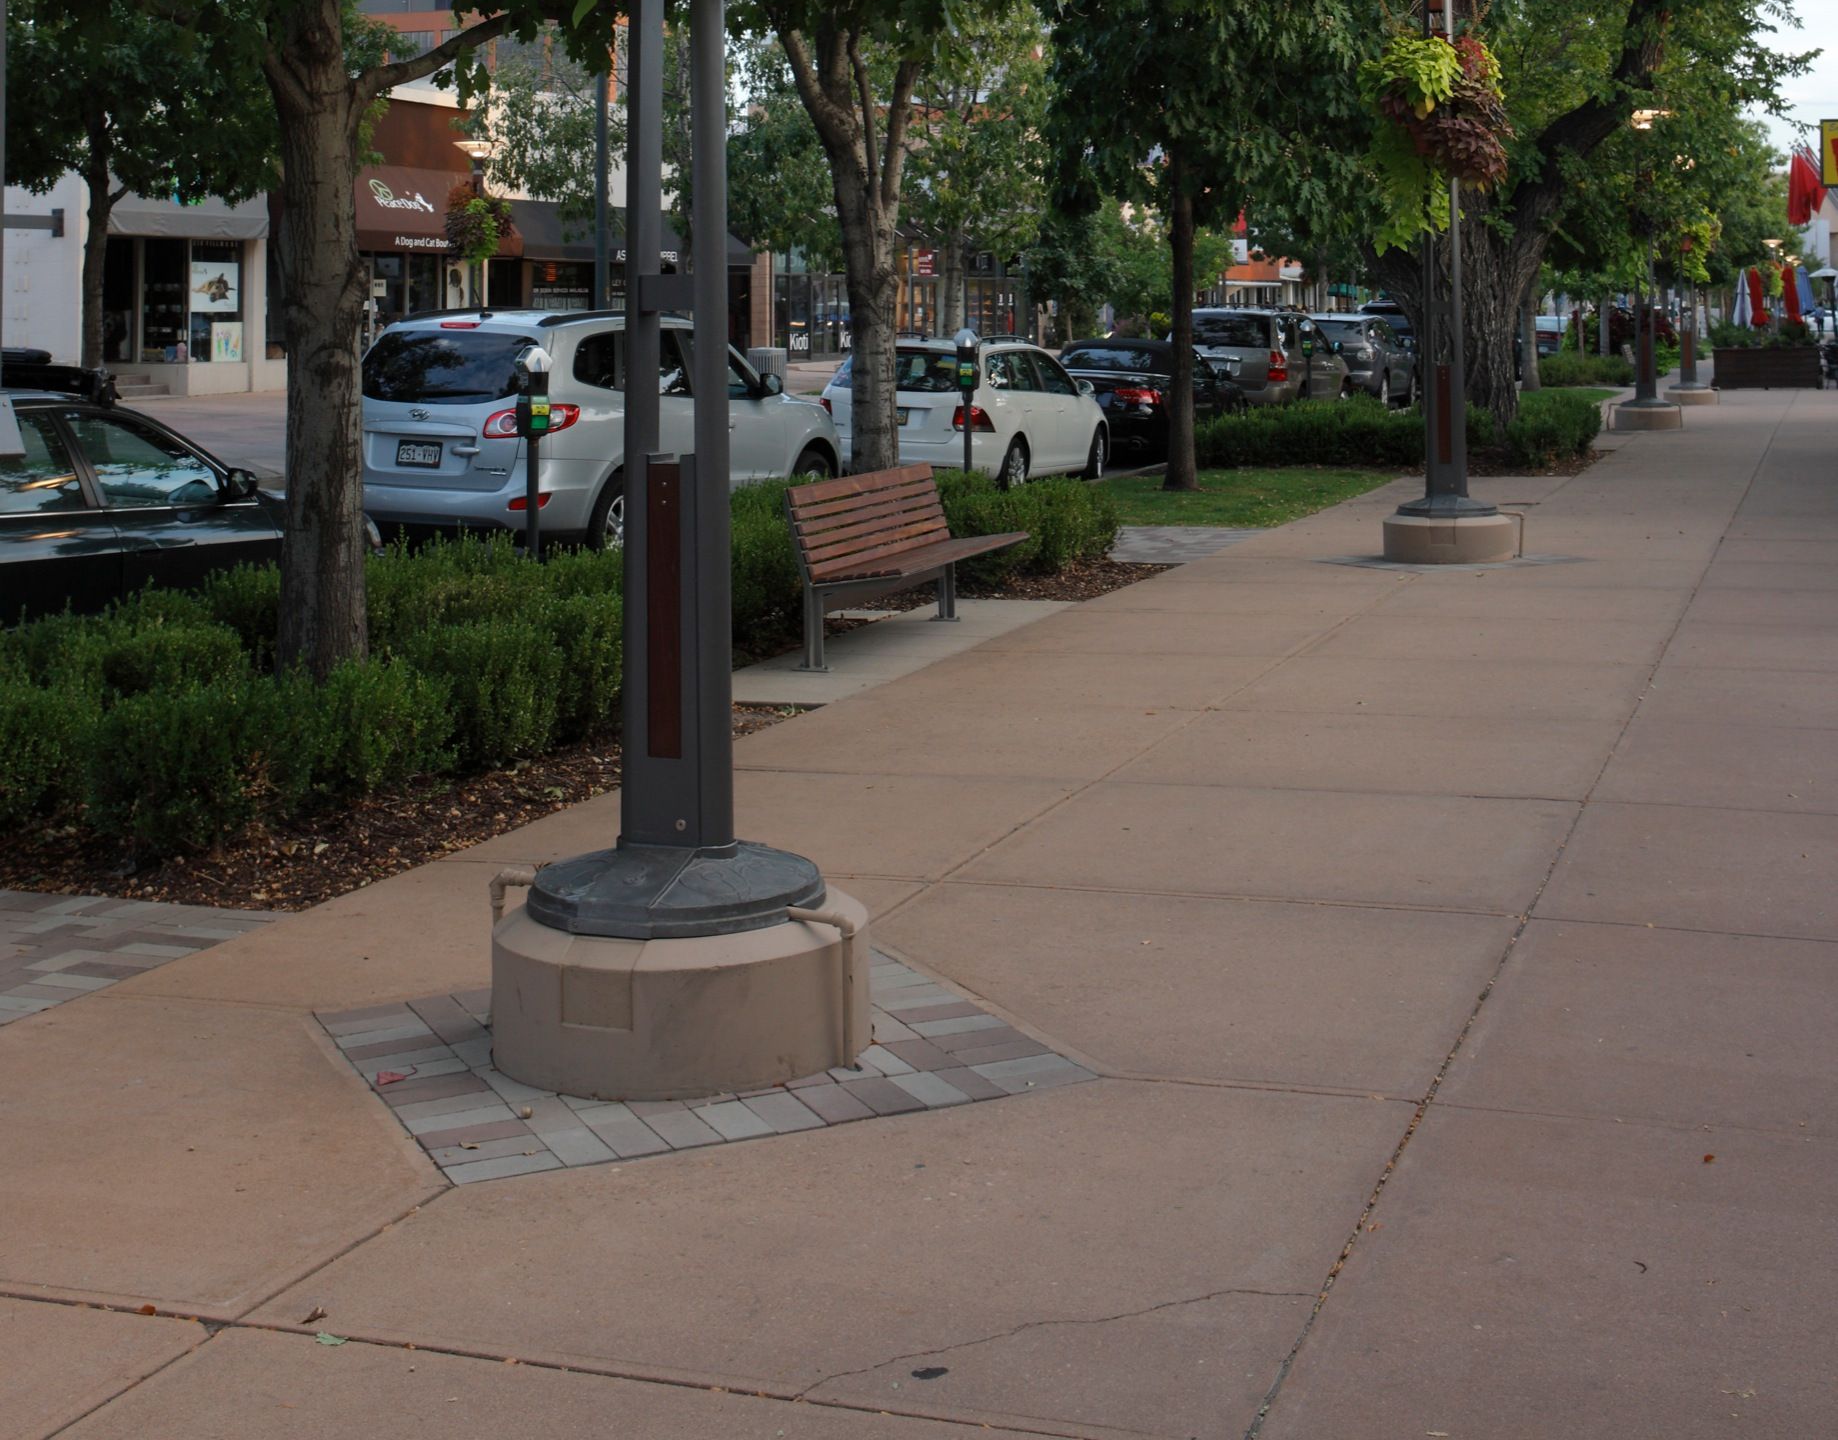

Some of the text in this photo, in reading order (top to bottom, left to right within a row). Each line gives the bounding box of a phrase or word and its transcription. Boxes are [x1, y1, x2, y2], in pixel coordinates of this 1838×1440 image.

[395, 236, 401, 246] A
[401, 236, 413, 248] Dog
[413, 237, 425, 247] and
[425, 237, 435, 248] Cat
[789, 333, 808, 351] Kioti
